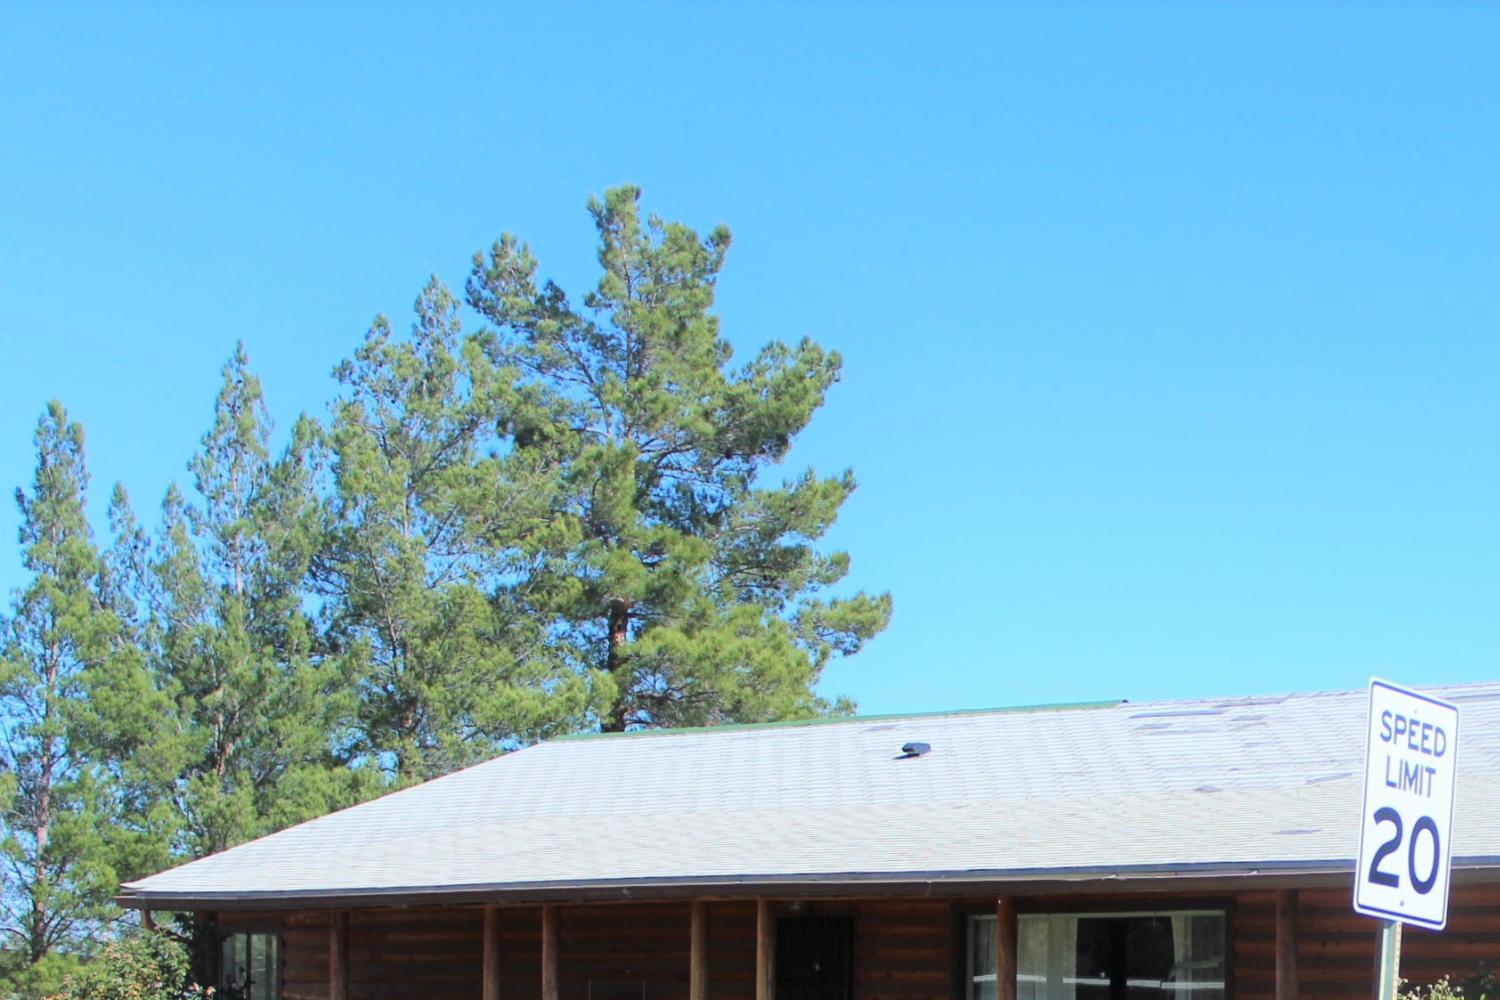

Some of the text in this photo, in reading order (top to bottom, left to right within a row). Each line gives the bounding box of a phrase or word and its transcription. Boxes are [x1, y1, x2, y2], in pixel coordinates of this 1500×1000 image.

[1380, 710, 1447, 757] SPEED
[1385, 755, 1436, 798] LIMIT
[1368, 806, 1440, 895] 20
